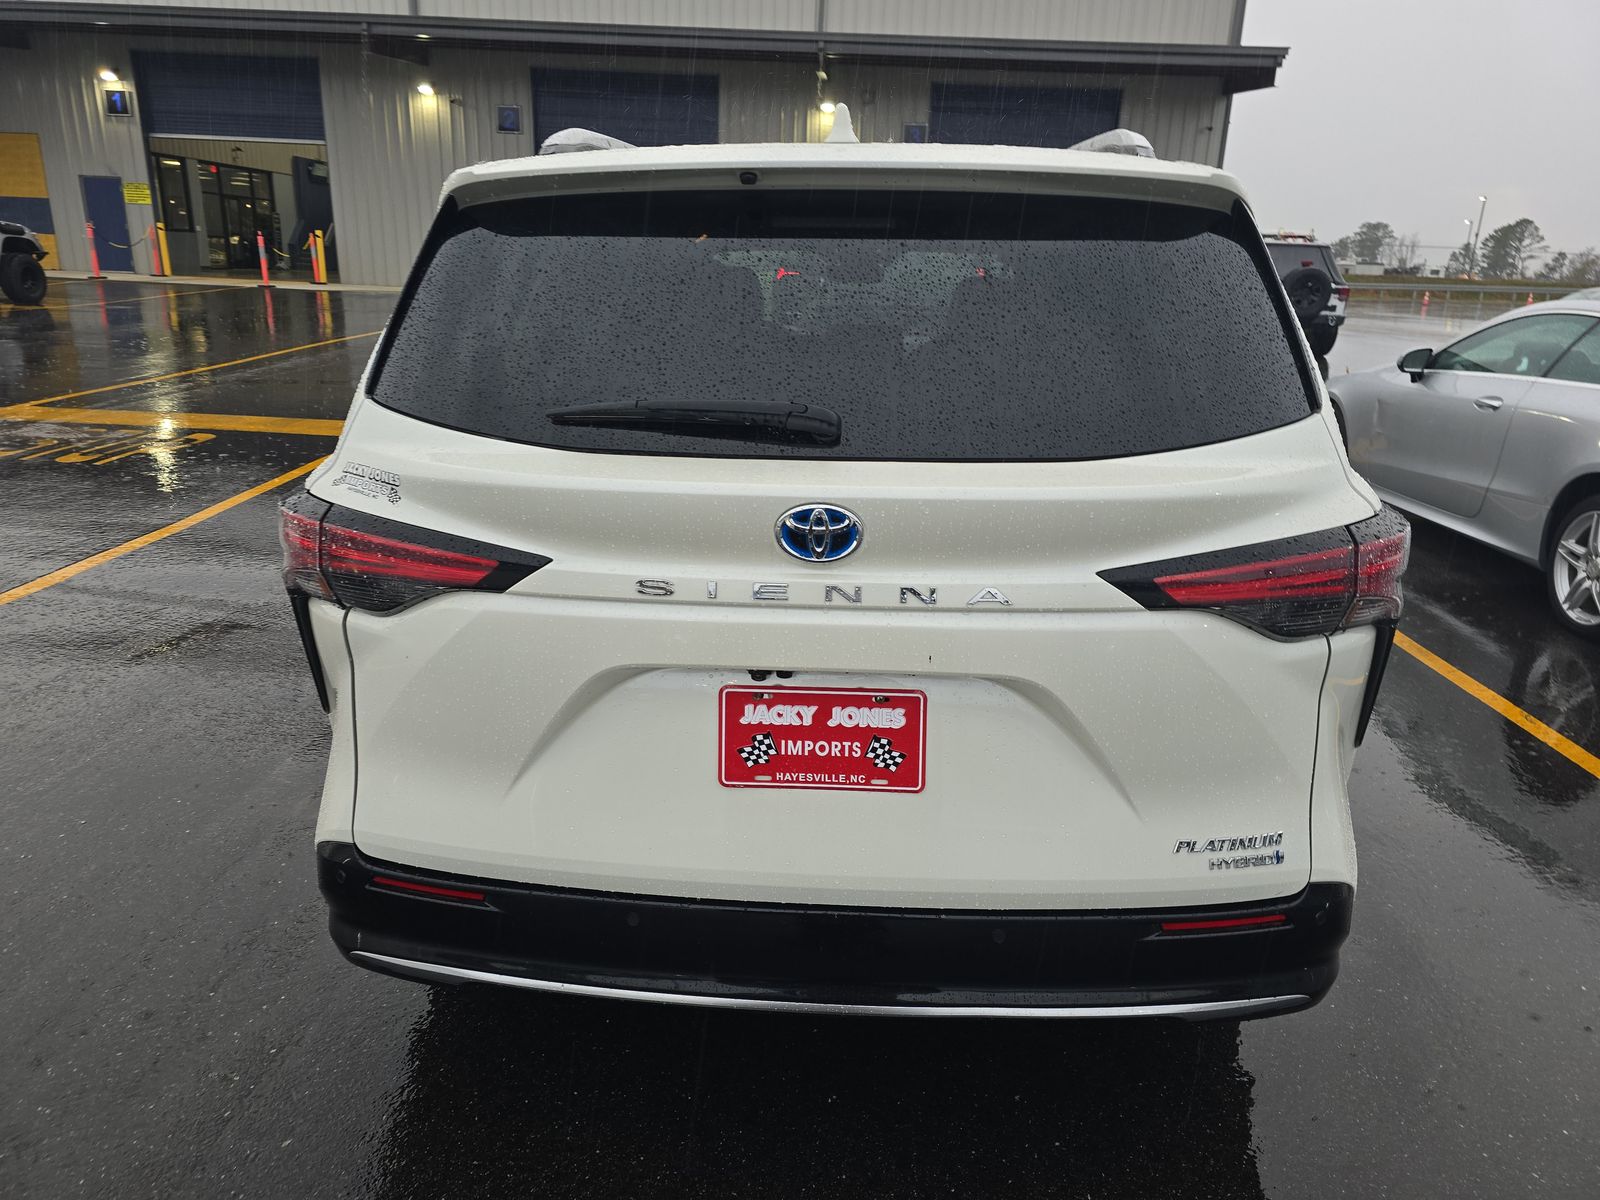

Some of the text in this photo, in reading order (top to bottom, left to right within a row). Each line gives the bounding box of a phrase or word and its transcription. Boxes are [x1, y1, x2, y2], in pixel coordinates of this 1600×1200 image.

[111, 92, 123, 112] 1
[343, 475, 391, 496] IMPORTS
[368, 467, 401, 487] JONES
[635, 578, 1013, 606] SIENNA
[739, 704, 907, 729] JACKY JONES
[780, 739, 862, 758] IMPORTS
[1173, 830, 1284, 854] PLATINUM
[1208, 855, 1273, 871] HYBRID
